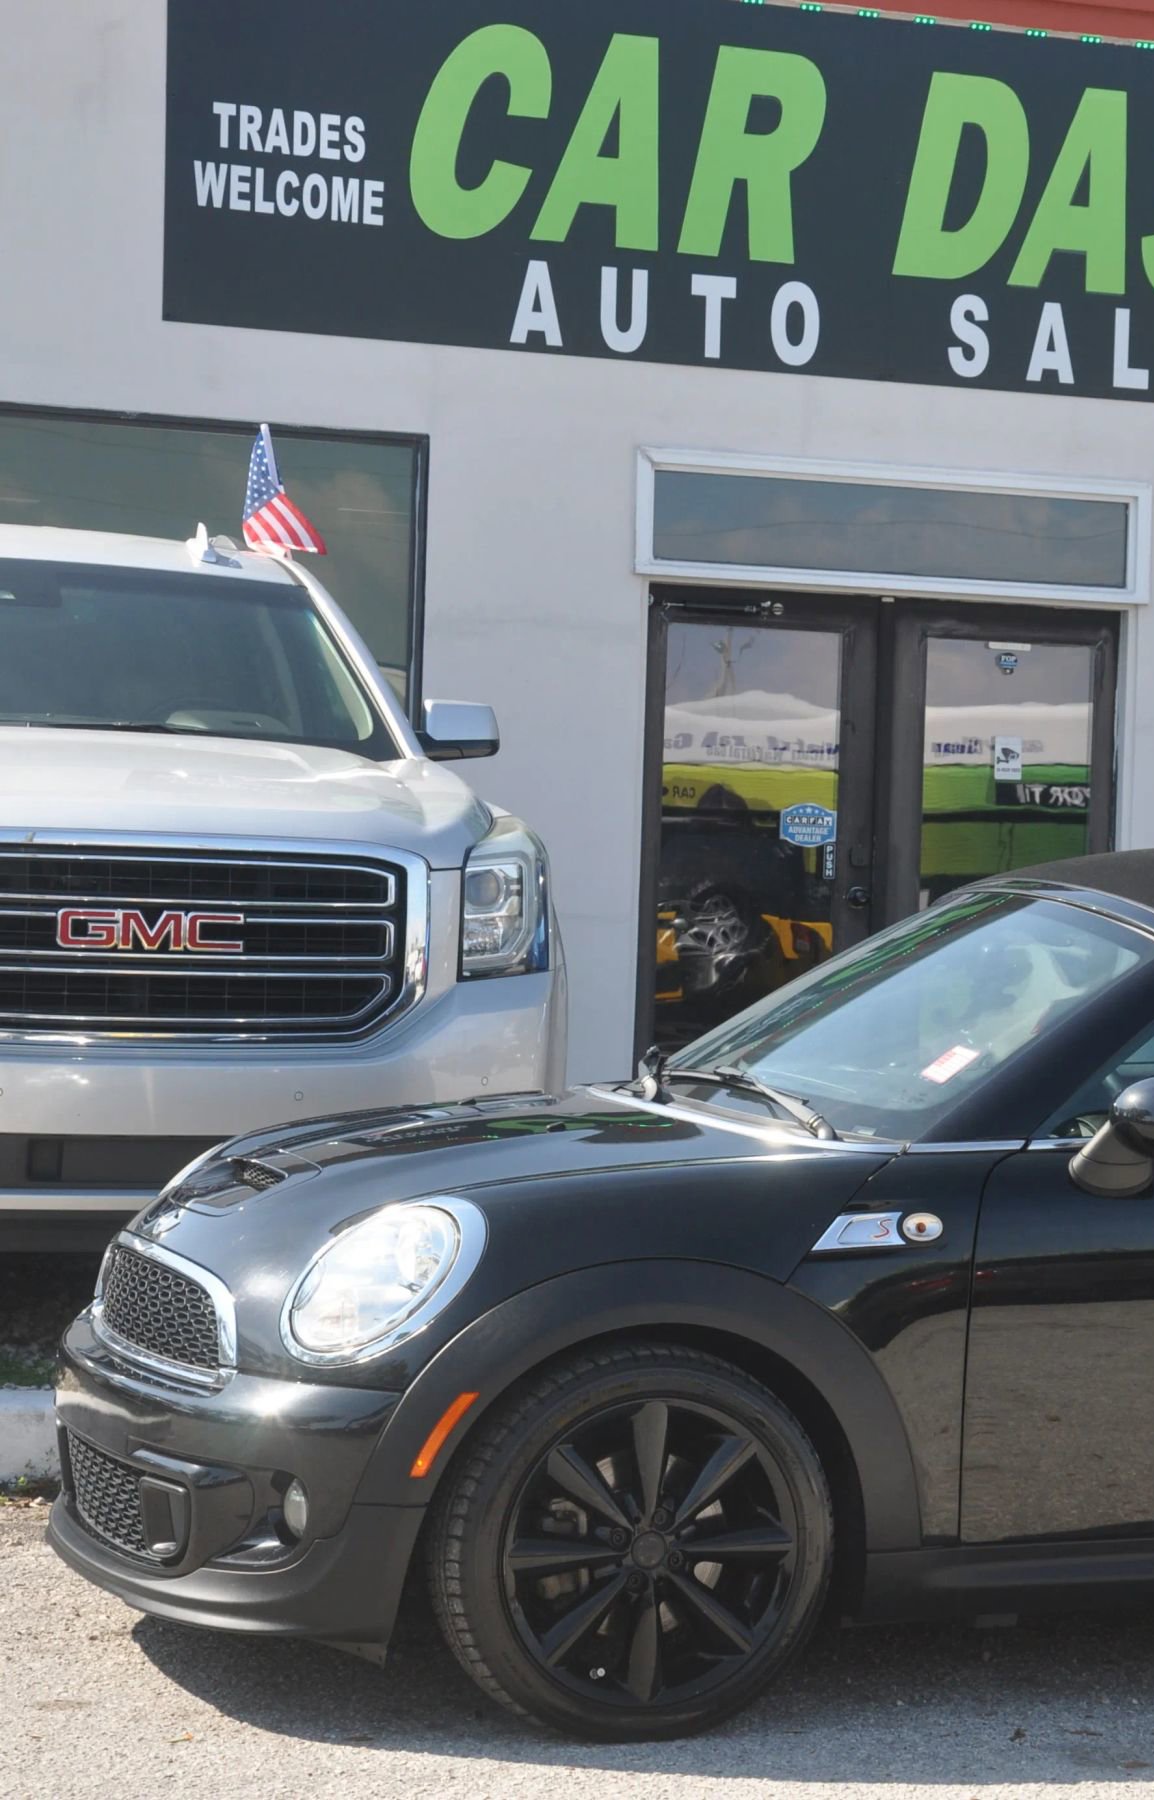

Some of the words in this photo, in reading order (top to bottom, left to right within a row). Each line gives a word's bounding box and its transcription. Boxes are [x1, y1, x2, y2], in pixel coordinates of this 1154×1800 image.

[212, 101, 366, 163] TRADES
[408, 23, 827, 264] CAR
[193, 159, 385, 227] WELCOME
[509, 259, 820, 367] AUTO
[786, 816, 833, 826] CARFAX
[788, 826, 830, 835] ADVANTAGE
[795, 834, 822, 842] DEALER
[825, 845, 834, 877] PUSH
[56, 908, 244, 953] GMC
